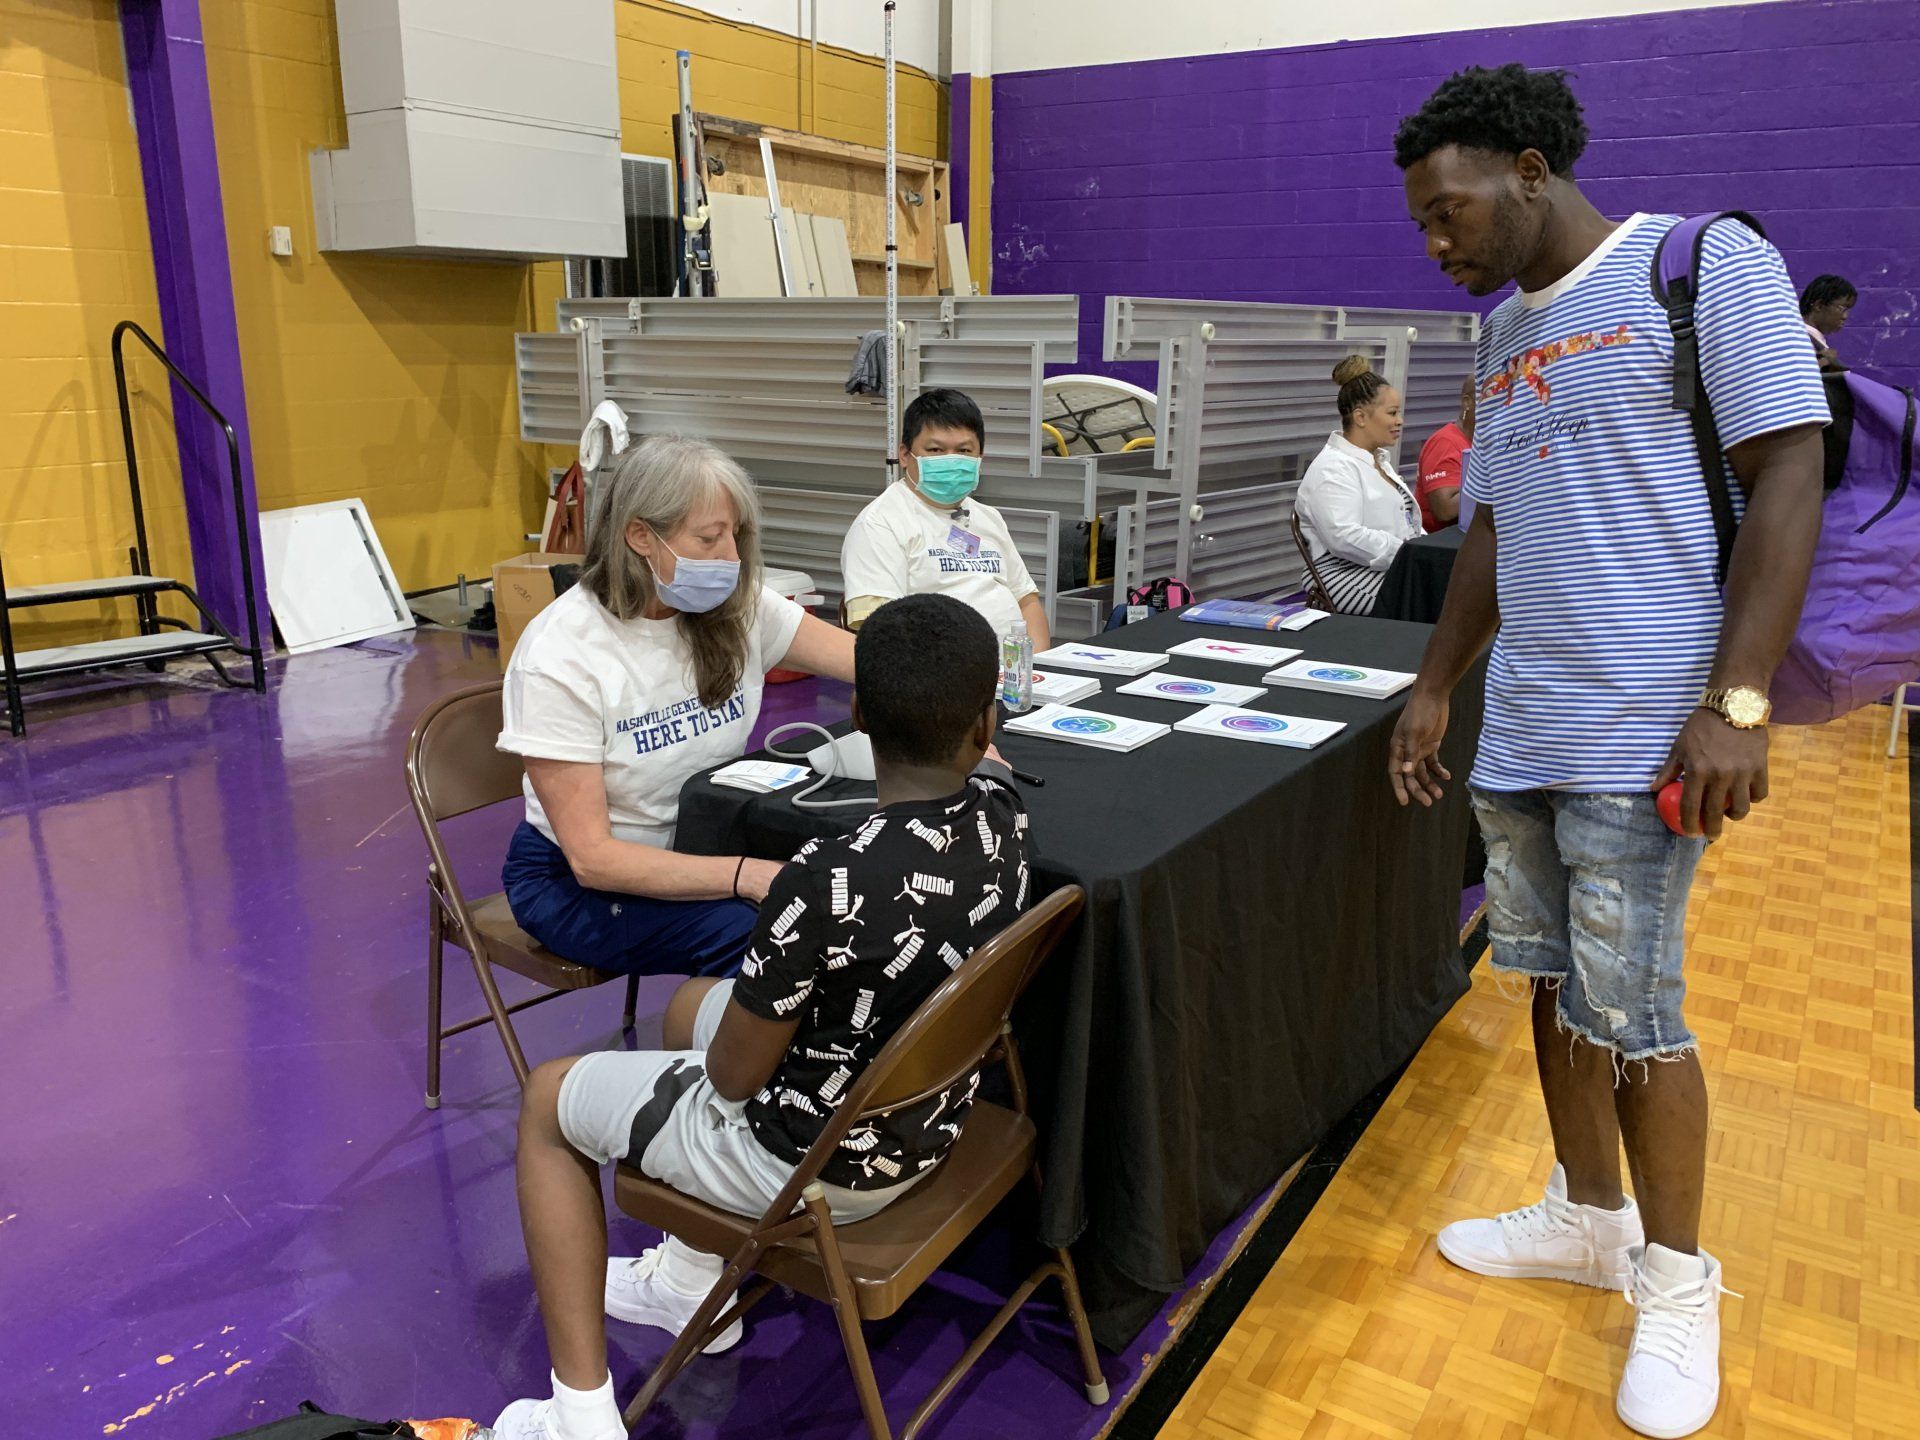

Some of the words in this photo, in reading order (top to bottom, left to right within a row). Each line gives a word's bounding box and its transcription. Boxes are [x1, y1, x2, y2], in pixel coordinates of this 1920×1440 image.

[939, 558, 968, 572] HERE
[967, 560, 981, 572] TO
[981, 560, 1000, 573] STAY
[616, 706, 671, 733] NASHVILLE
[633, 719, 687, 754] HERE
[687, 711, 708, 737] TO
[708, 694, 745, 728] STAY
[849, 819, 887, 853] PUMA
[905, 818, 947, 852] PUMA
[977, 810, 994, 854] PUMA
[831, 867, 848, 915] PUMA
[911, 872, 954, 896] PUMA
[770, 896, 807, 939] PUMA
[968, 891, 1000, 927] PUMA
[883, 934, 924, 980] PUMA
[850, 988, 875, 1029] PUMA
[818, 1065, 852, 1101] PUMA
